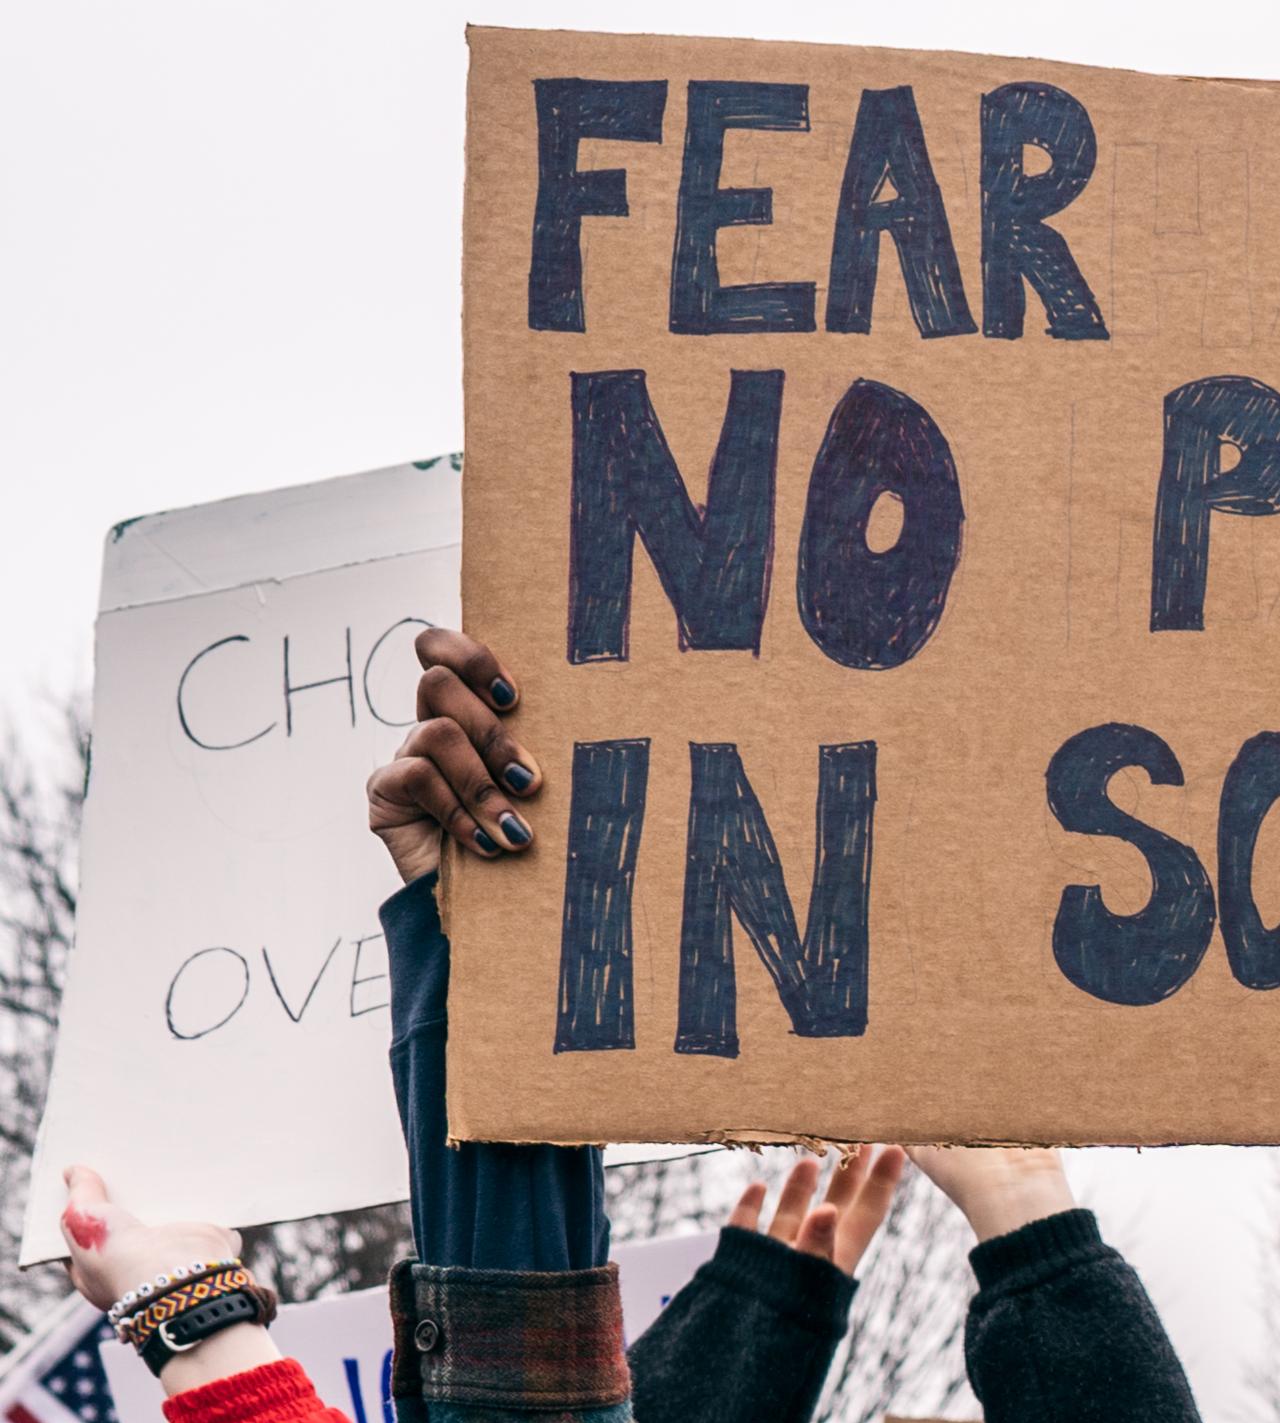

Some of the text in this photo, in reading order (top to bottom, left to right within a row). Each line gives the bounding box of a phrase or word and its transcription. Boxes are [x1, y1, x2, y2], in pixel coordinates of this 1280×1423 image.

[527, 77, 1111, 342] FEAR
[566, 368, 966, 672] NO
[552, 737, 878, 1059] IN
